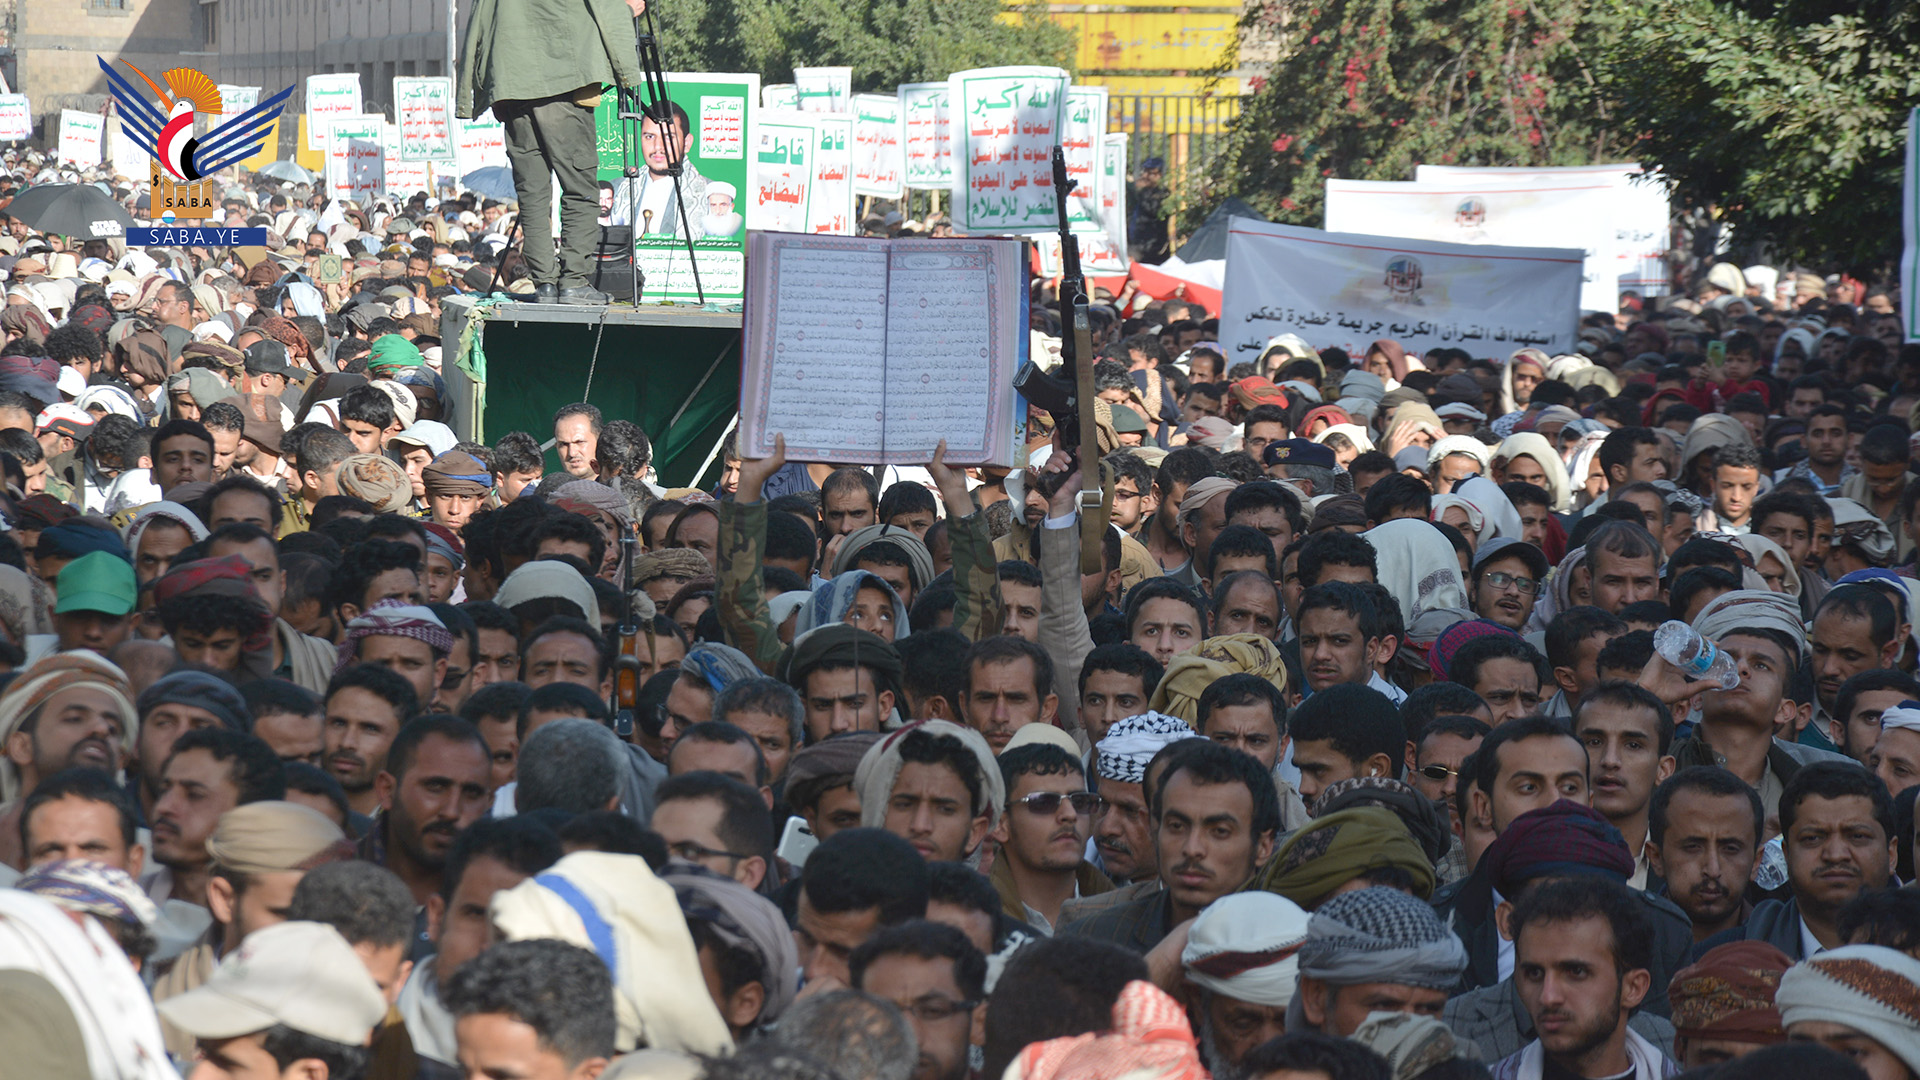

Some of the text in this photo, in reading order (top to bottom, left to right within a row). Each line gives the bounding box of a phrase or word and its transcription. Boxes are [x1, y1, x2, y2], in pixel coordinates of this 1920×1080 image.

[429, 88, 446, 98] الله
[971, 80, 1059, 118] الله أكبر
[333, 124, 379, 142] قاطعوا
[971, 115, 1055, 140] الموت لأمريكا
[972, 144, 1054, 167] الموت لإسرائيل
[971, 170, 1006, 193] اليهود
[1009, 170, 1028, 192] على
[759, 179, 805, 209] البضائع
[971, 195, 1018, 225] للإسلام
[1245, 306, 1556, 348] استهداف القرآن الكريم جريمة خطيرة تعكس
[1237, 336, 1262, 353] على
